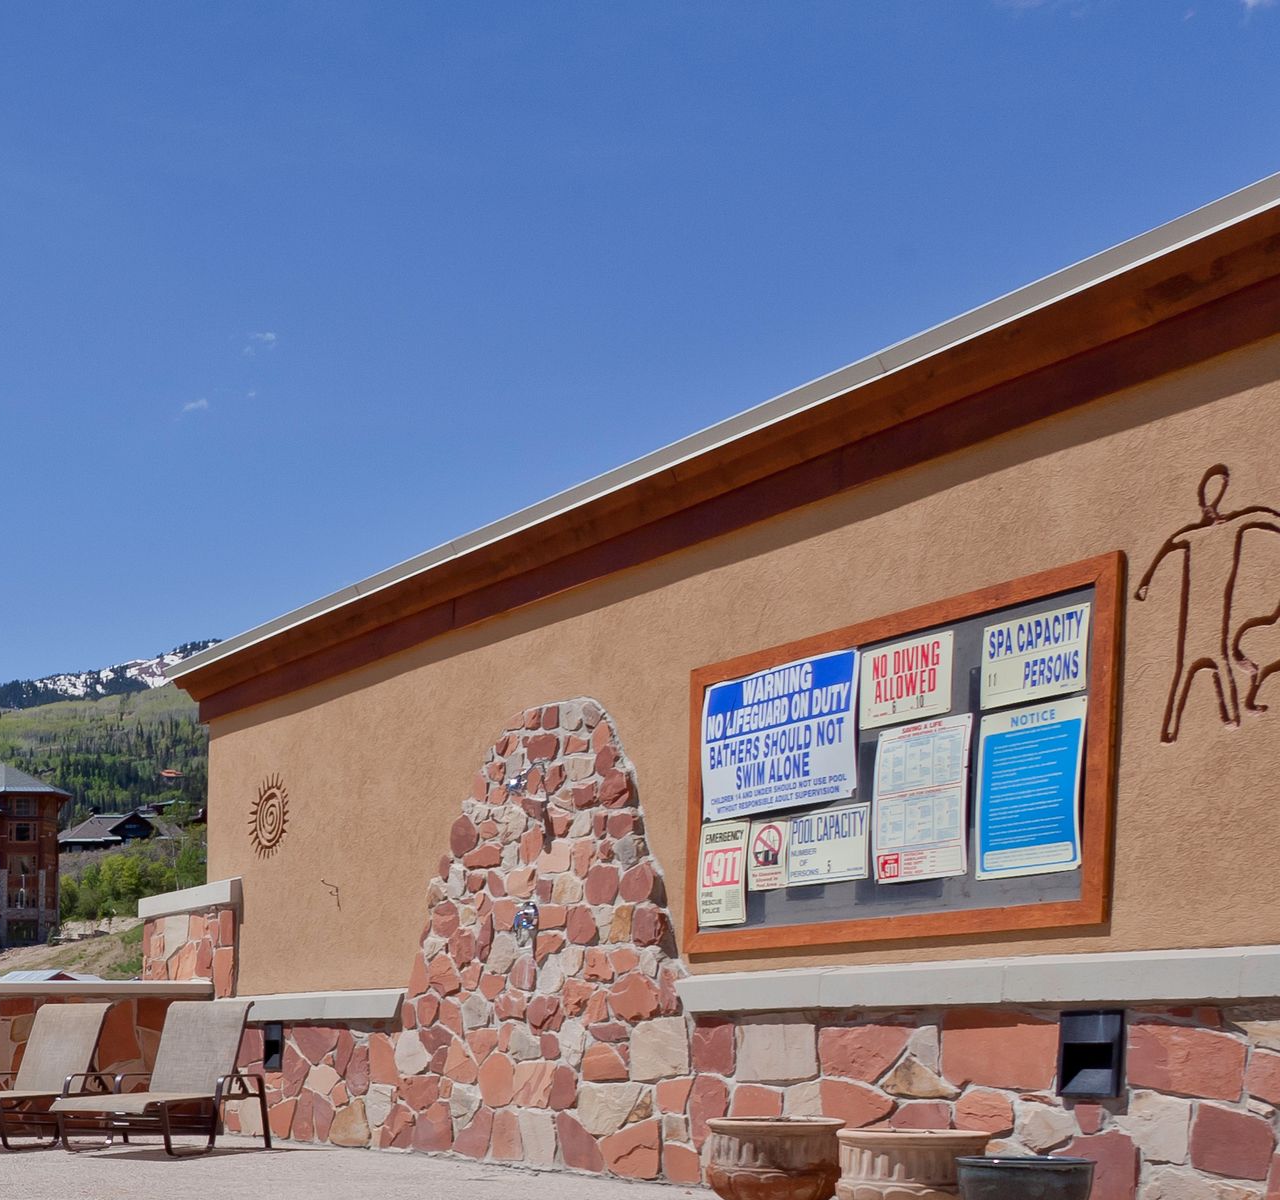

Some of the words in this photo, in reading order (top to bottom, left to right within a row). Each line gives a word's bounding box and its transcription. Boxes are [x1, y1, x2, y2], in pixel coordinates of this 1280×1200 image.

[989, 627, 1013, 660] SPA
[1017, 609, 1084, 652] CAPACITY
[873, 653, 887, 681] NO
[893, 641, 941, 675] DIVING
[1023, 649, 1079, 689] PERSONS
[743, 663, 813, 706] WARNING
[874, 667, 936, 704] ALLOWED
[707, 713, 724, 741] NO
[726, 697, 789, 737] LIFEGUARD
[791, 691, 810, 721] ON
[812, 682, 850, 716] DUTY
[1010, 709, 1056, 728] NOTICE
[710, 736, 760, 770] BATHERS
[763, 724, 812, 759] SHOULD
[816, 717, 844, 748] NOT
[736, 761, 766, 790] SWIM
[768, 752, 810, 784] ALONE
[711, 795, 734, 805] CHILDREN
[742, 790, 753, 799] AND
[754, 787, 772, 797] UNDER
[773, 783, 797, 793] SHOULD
[798, 780, 812, 788] NOT
[813, 777, 827, 786] USE
[828, 773, 847, 784] POOL
[717, 803, 739, 814] WITHOUT
[740, 798, 775, 811] RESPONSIBLE
[775, 794, 794, 804] ADULT
[795, 785, 840, 800] SUPERVISION
[705, 829, 744, 845] EMERGENCY
[792, 818, 815, 845] POOL
[817, 810, 865, 842] CAPACITY
[712, 850, 741, 884] 911
[791, 848, 817, 857] NUMBER
[799, 859, 809, 867] OF
[790, 868, 819, 878] PERSONS
